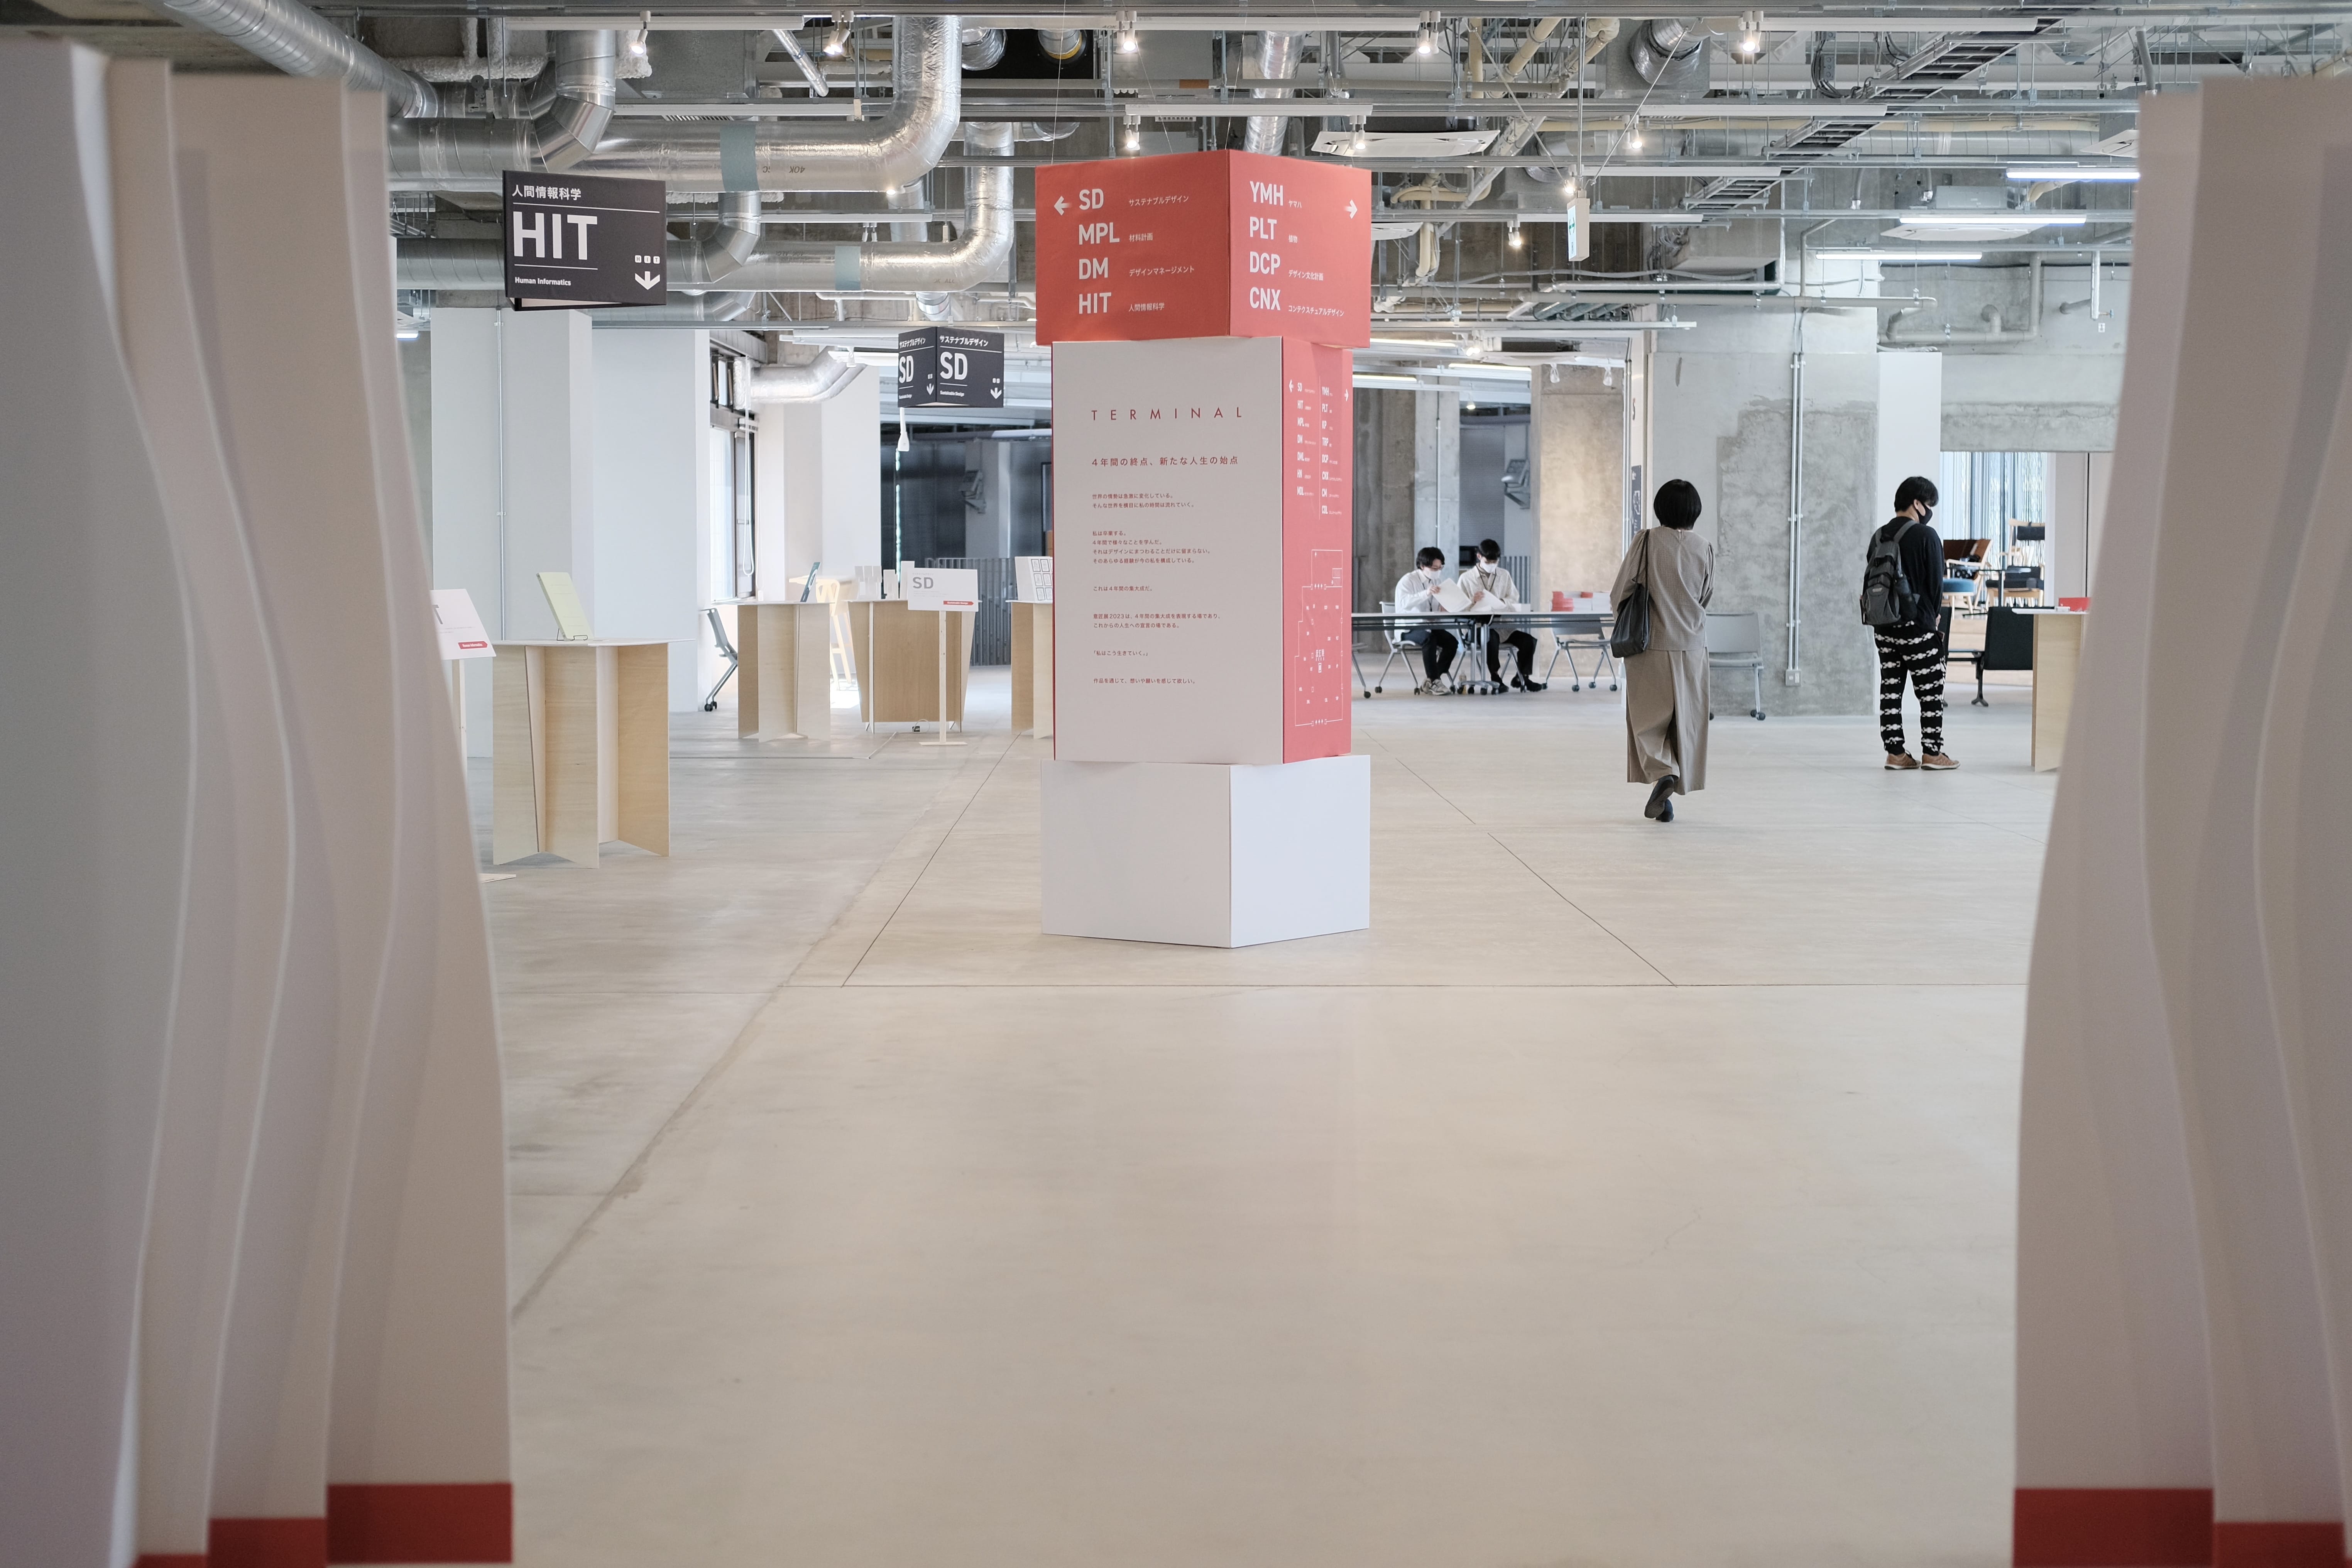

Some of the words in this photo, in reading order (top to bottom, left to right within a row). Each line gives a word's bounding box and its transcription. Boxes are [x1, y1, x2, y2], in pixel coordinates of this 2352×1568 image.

[512, 184, 582, 201] 人間情報科学
[1079, 188, 1104, 210] SD
[1129, 195, 1189, 206] サステナブルデザイン
[1250, 181, 1283, 206] YMH
[1288, 200, 1302, 208] ヤマハ
[513, 211, 597, 260] HIT
[1079, 222, 1120, 245] MPL
[1129, 233, 1153, 242] 材料計画
[1250, 216, 1277, 240] PLT
[1288, 235, 1298, 243] 植物
[1079, 257, 1108, 279] DM
[1129, 265, 1194, 277] デザインマネージメント
[1250, 251, 1280, 275] DCP
[1288, 270, 1324, 281] デザイン文化計画
[537, 278, 571, 286] Informatics
[1079, 292, 1112, 314] HIT
[1128, 302, 1165, 312] 人間情報科学
[1250, 287, 1281, 311] CNX
[1288, 305, 1344, 317] コンテクスチュアルデザイン
[939, 335, 989, 347] サステナブルデザイン
[899, 355, 914, 383] SD
[940, 352, 968, 380] SD
[1297, 382, 1302, 392] SD
[1091, 407, 1242, 421] TERMINAL
[1322, 420, 1327, 429] KP
[1092, 456, 1238, 467] 4年間の終点、新たな人生の始点
[912, 577, 934, 589] SD
